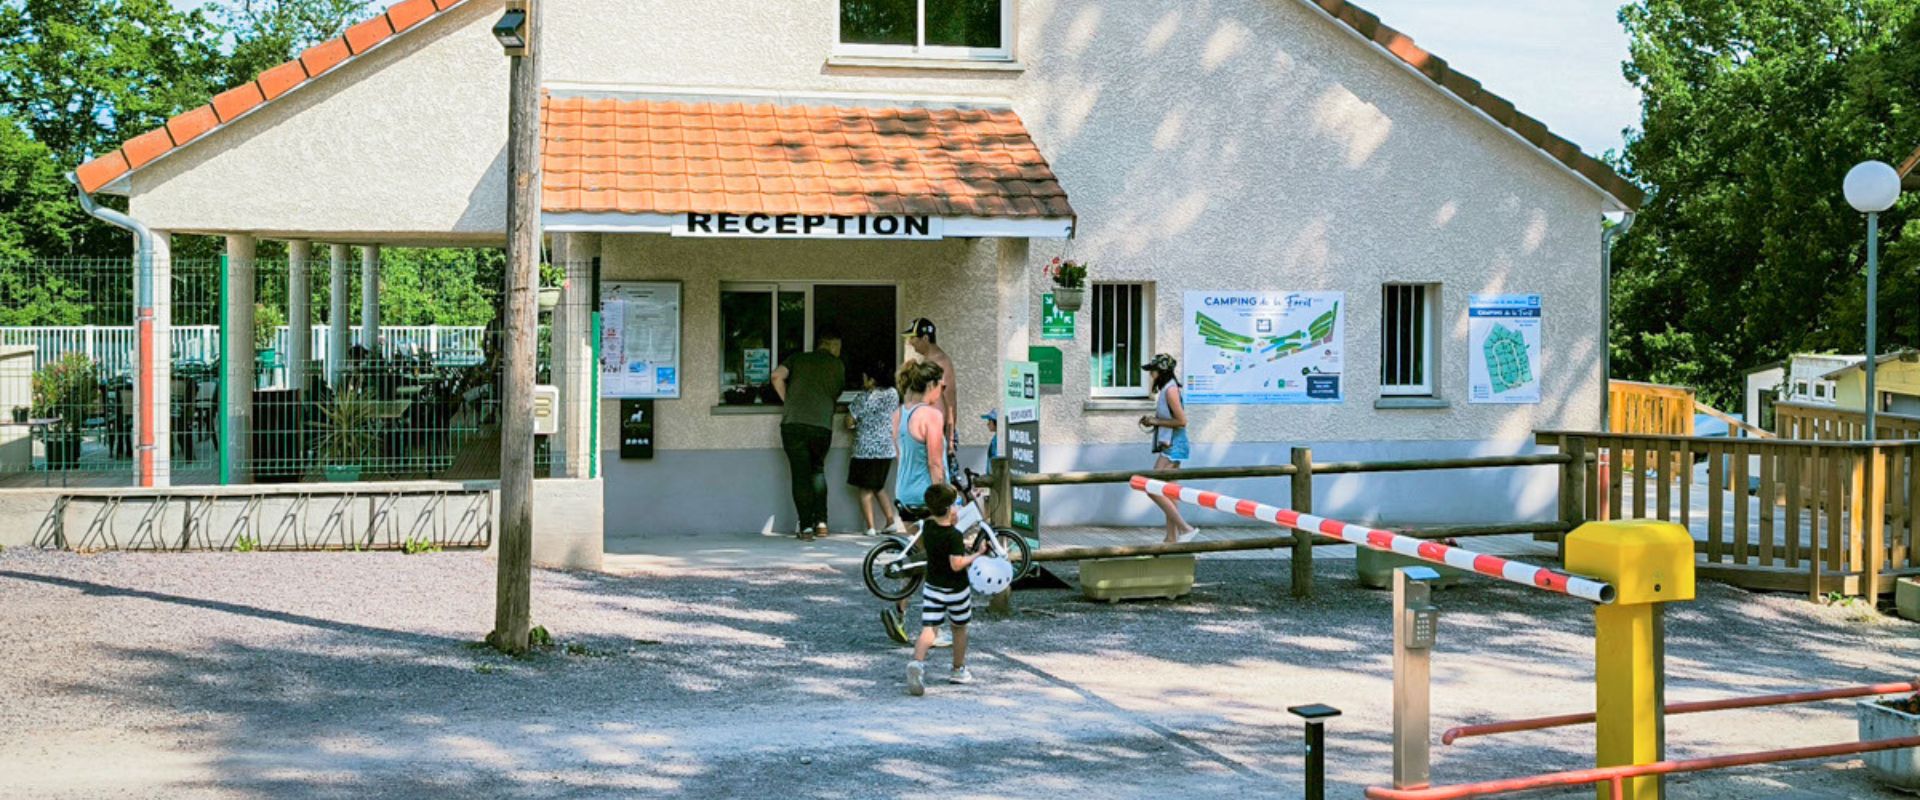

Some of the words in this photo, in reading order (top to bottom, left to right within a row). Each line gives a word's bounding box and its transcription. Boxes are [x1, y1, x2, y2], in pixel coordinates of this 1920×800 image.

[687, 212, 930, 235] RECEPTION
[1204, 296, 1257, 306] CAMPING
[1012, 447, 1034, 463] HOME
[1013, 486, 1031, 503] BOIS
